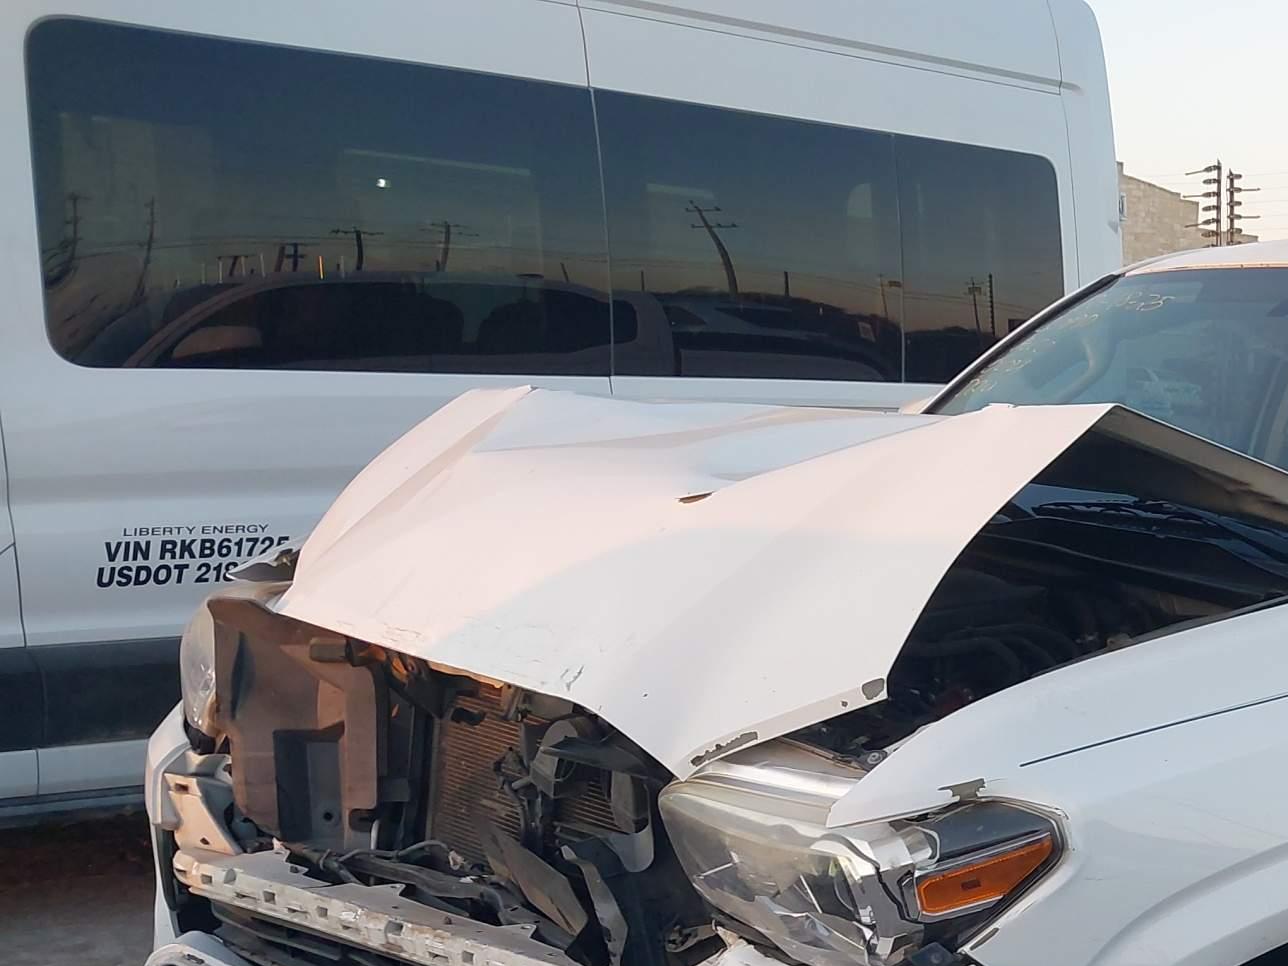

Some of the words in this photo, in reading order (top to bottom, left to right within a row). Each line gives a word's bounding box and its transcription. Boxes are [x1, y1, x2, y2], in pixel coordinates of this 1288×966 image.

[123, 526, 196, 537] LIBERTY
[201, 524, 269, 535] ENERGY
[105, 540, 151, 562] VIN
[96, 564, 190, 588] USDOT
